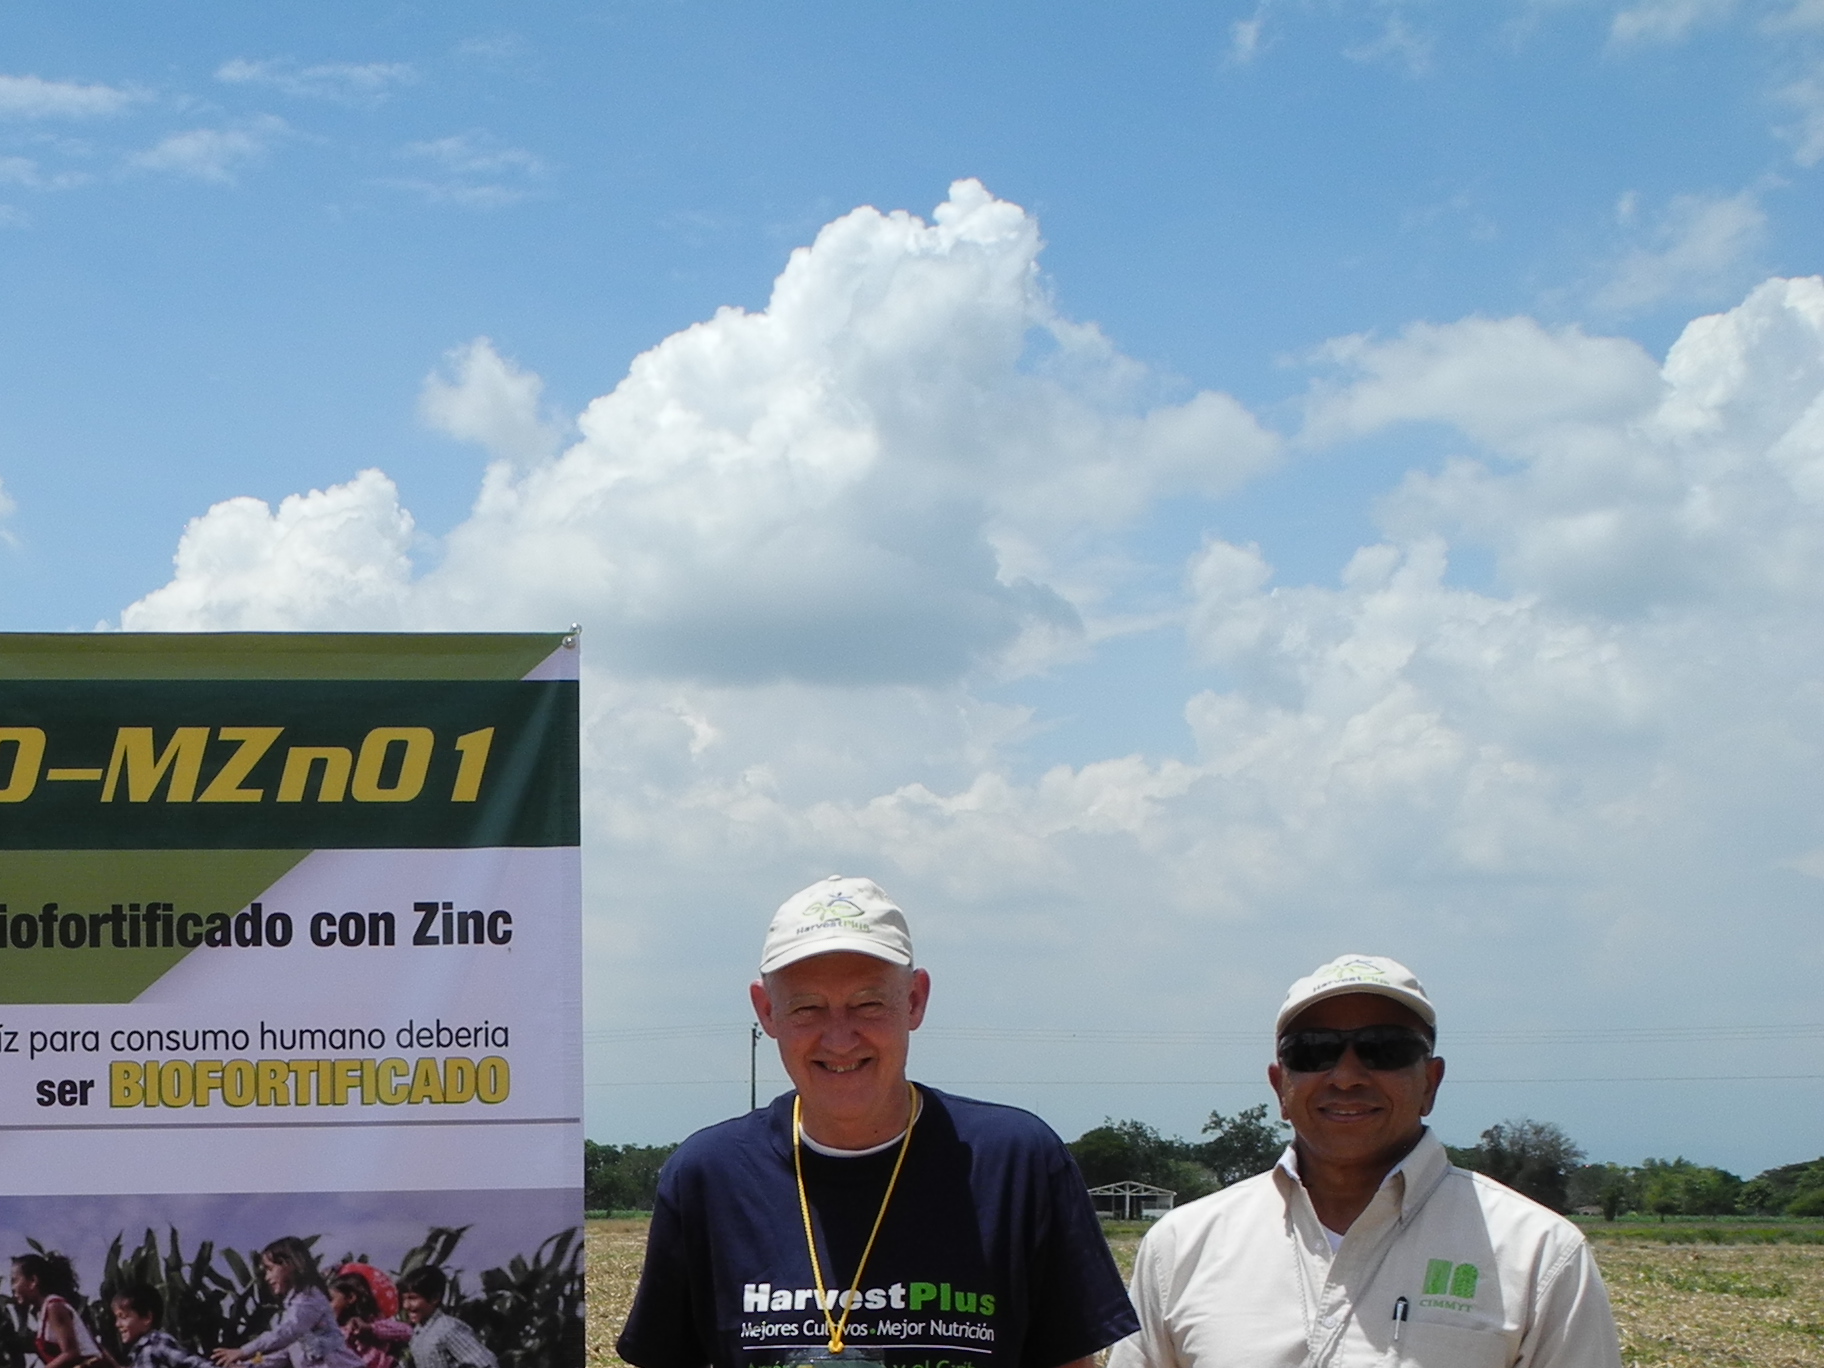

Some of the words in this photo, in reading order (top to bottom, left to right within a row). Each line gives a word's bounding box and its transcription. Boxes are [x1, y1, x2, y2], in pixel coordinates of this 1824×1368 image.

[310, 911, 395, 947] con
[413, 901, 513, 946] Zinc
[29, 1028, 99, 1059] para
[109, 1027, 249, 1052] consumo
[259, 1022, 385, 1050] humano
[396, 1019, 510, 1049] deberia
[36, 1072, 94, 1108] ser
[109, 1056, 511, 1108] BIOFORTIFICADO
[743, 1281, 996, 1316] HarvestPlus
[1419, 1300, 1473, 1313] CIMMYT
[740, 1322, 799, 1341] Mejores
[930, 1319, 995, 1342] Nutrición
